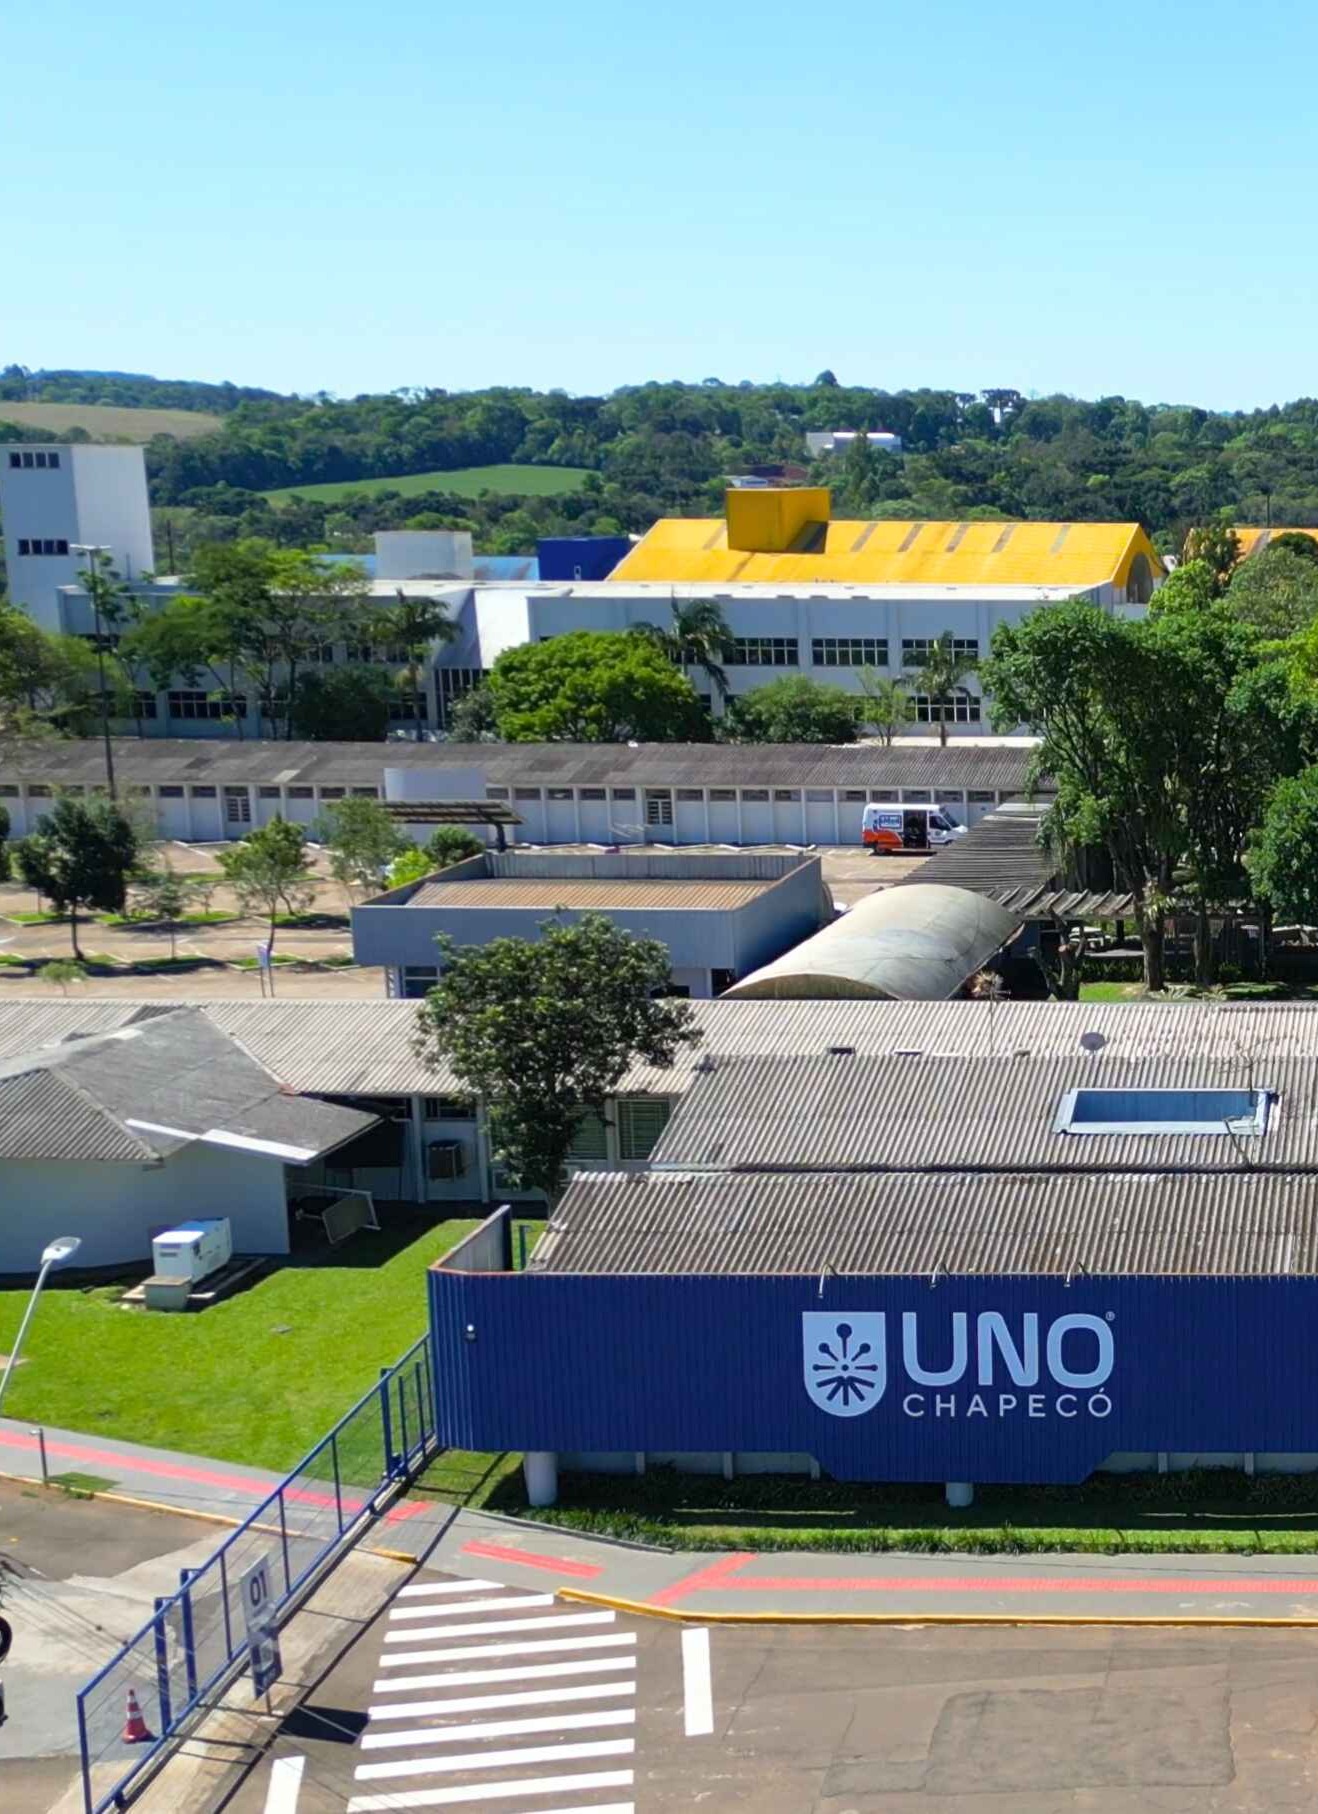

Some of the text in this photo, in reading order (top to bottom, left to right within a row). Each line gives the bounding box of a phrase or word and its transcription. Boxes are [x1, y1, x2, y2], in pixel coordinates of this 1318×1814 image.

[902, 1311, 1114, 1388] UNO
[902, 1388, 1112, 1418] CHAPECÓ
[250, 1568, 268, 1607] 01
